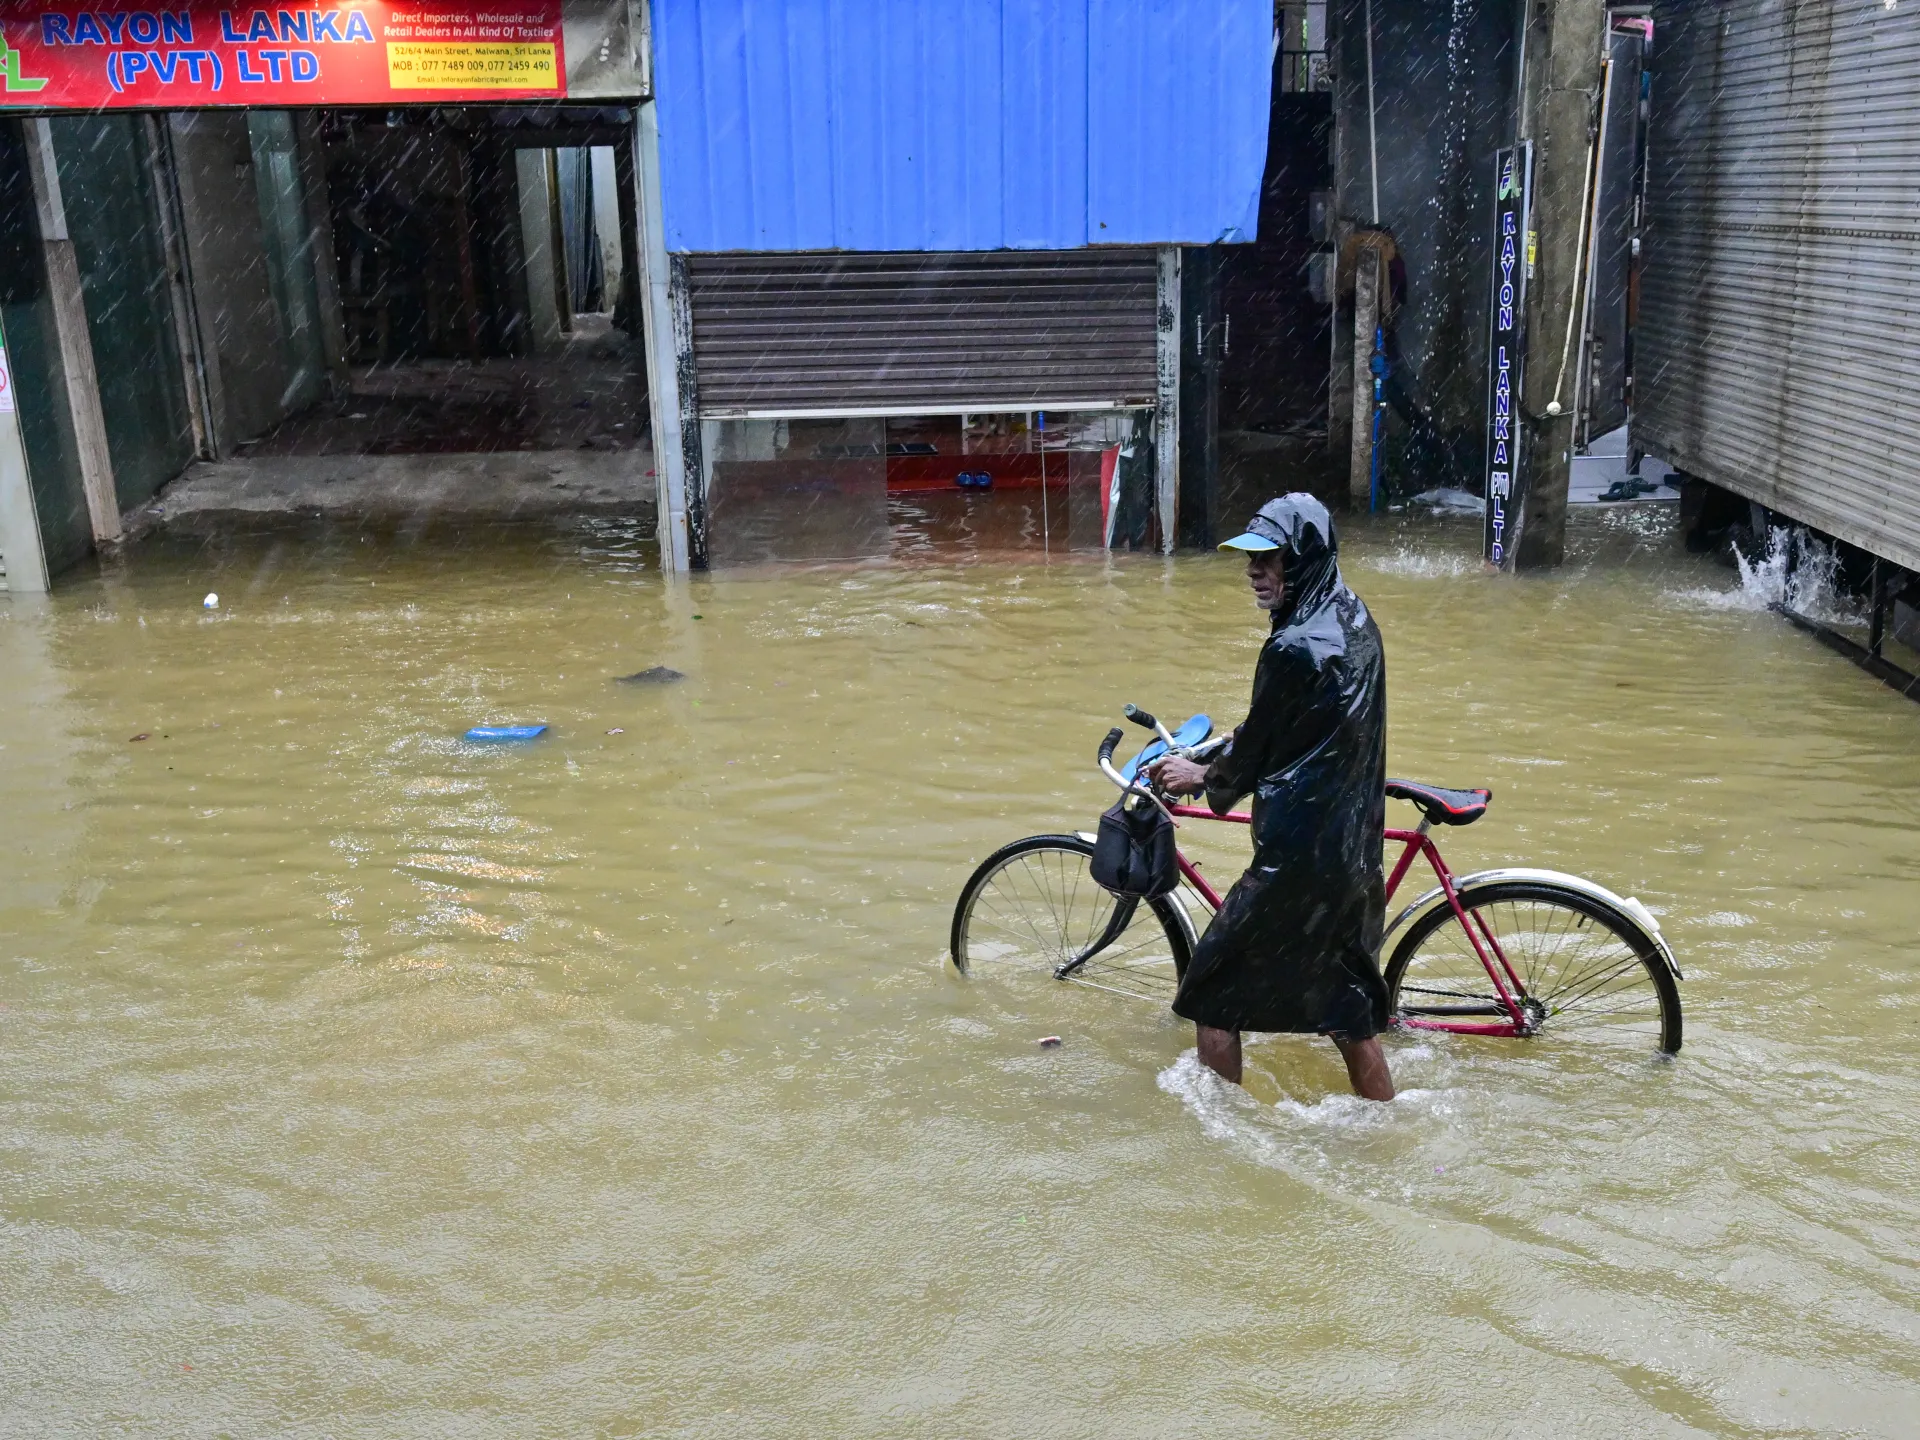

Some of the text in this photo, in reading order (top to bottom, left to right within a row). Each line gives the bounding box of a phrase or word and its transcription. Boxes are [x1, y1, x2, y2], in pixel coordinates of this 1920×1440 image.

[40, 10, 376, 46] RAYON LANKA
[384, 26, 554, 39] Retail Dealers In All Kind Of Textiles
[392, 12, 546, 24] Direct Importers, Wholesale and
[392, 61, 413, 71] MOB
[421, 61, 439, 70] 077
[442, 61, 464, 70] 7489
[508, 61, 530, 70] 2459
[533, 61, 550, 70] 490
[394, 47, 422, 55] 52/6/4
[424, 47, 443, 55] Main
[445, 47, 473, 56] Street,
[475, 48, 513, 56] Malwana,
[515, 47, 526, 55] Sri
[107, 50, 319, 92] (PVT) LTD
[1499, 211, 1516, 331] RAYON
[1494, 346, 1510, 464] LANKA
[1492, 496, 1505, 564] LTD
